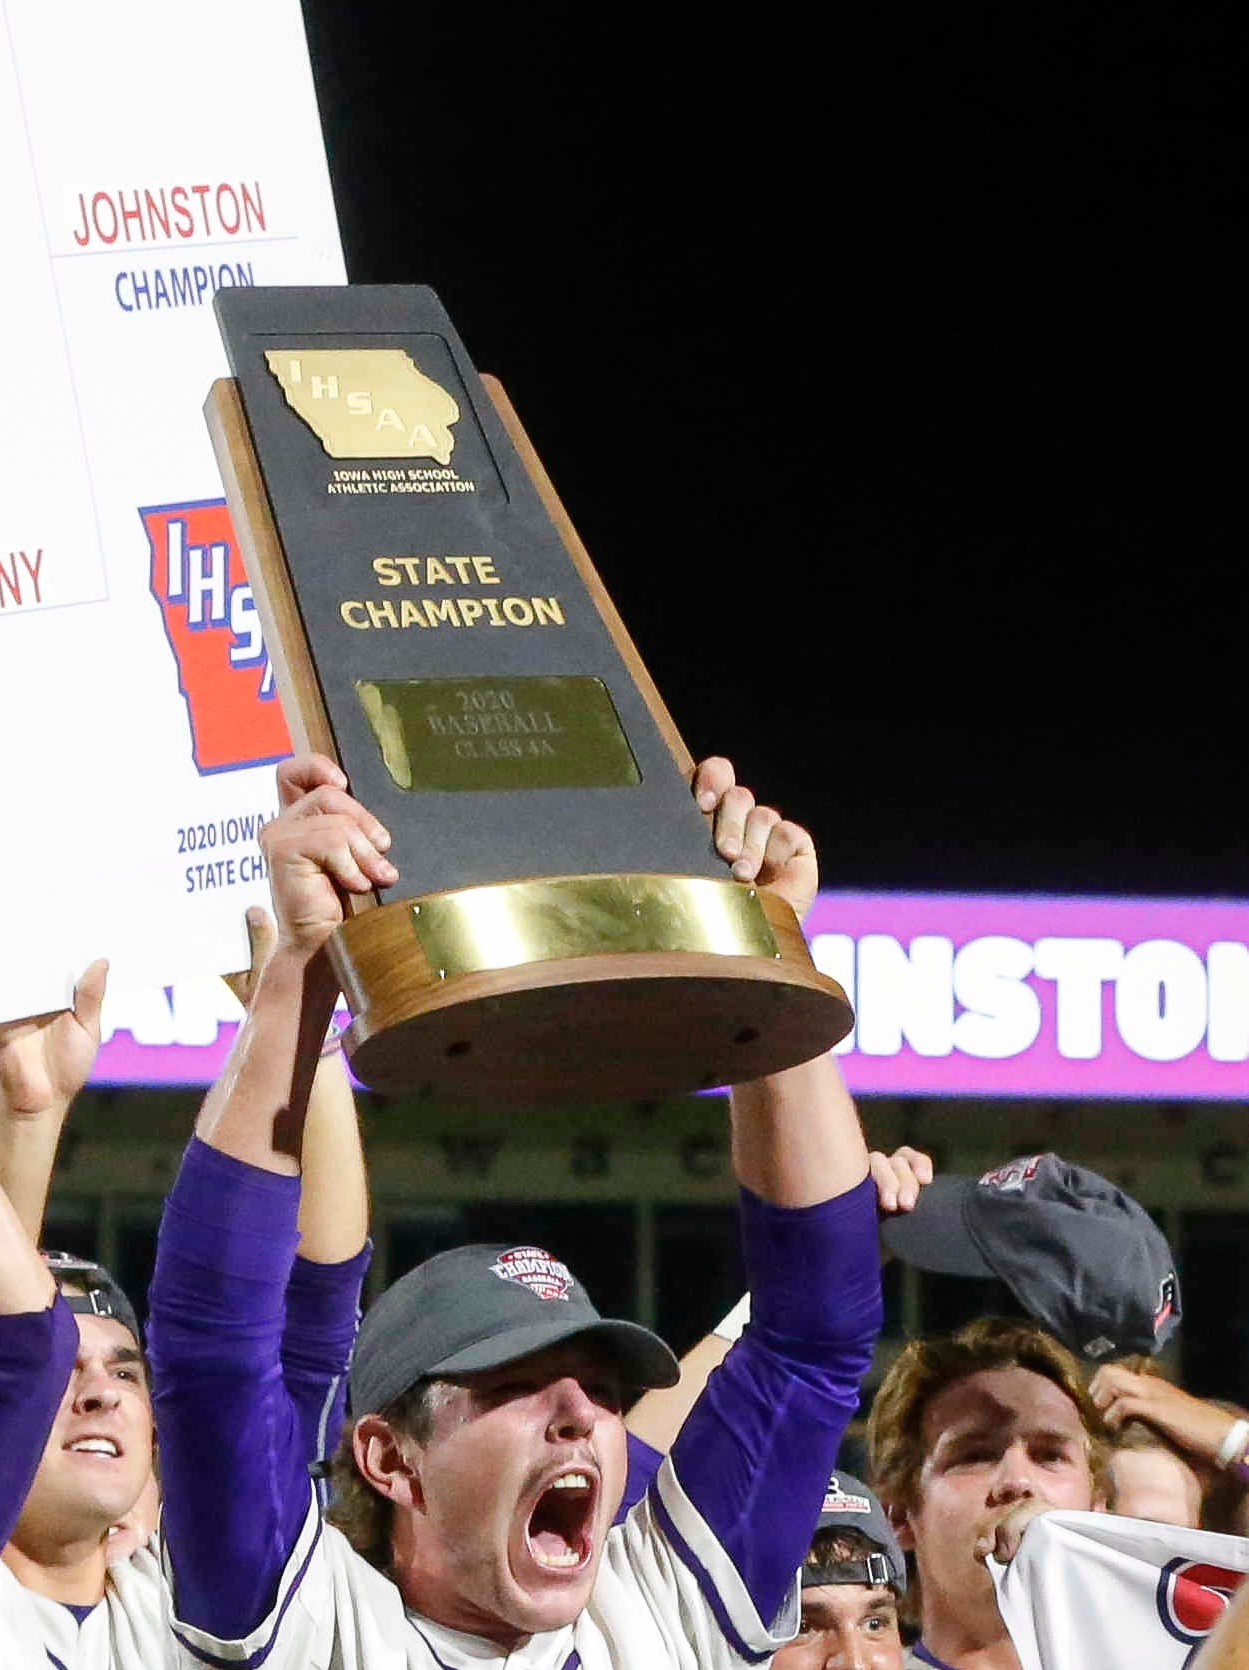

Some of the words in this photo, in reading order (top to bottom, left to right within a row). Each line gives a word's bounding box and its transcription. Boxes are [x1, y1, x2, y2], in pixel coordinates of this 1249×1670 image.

[74, 181, 266, 246] JOHNSTON
[289, 360, 438, 449] IHSAA
[327, 482, 388, 495] ATHLETIC
[390, 480, 476, 494] ASSOCIATION
[333, 470, 370, 482] IOWA
[373, 469, 406, 481] HIGH
[408, 468, 459, 480] SCHOOL
[371, 555, 501, 588] STATE
[339, 596, 566, 631] CHAMPION
[455, 689, 515, 713] 2020
[427, 711, 563, 736] BASEBALL
[176, 822, 217, 854] 2020
[185, 859, 236, 893] STATE
